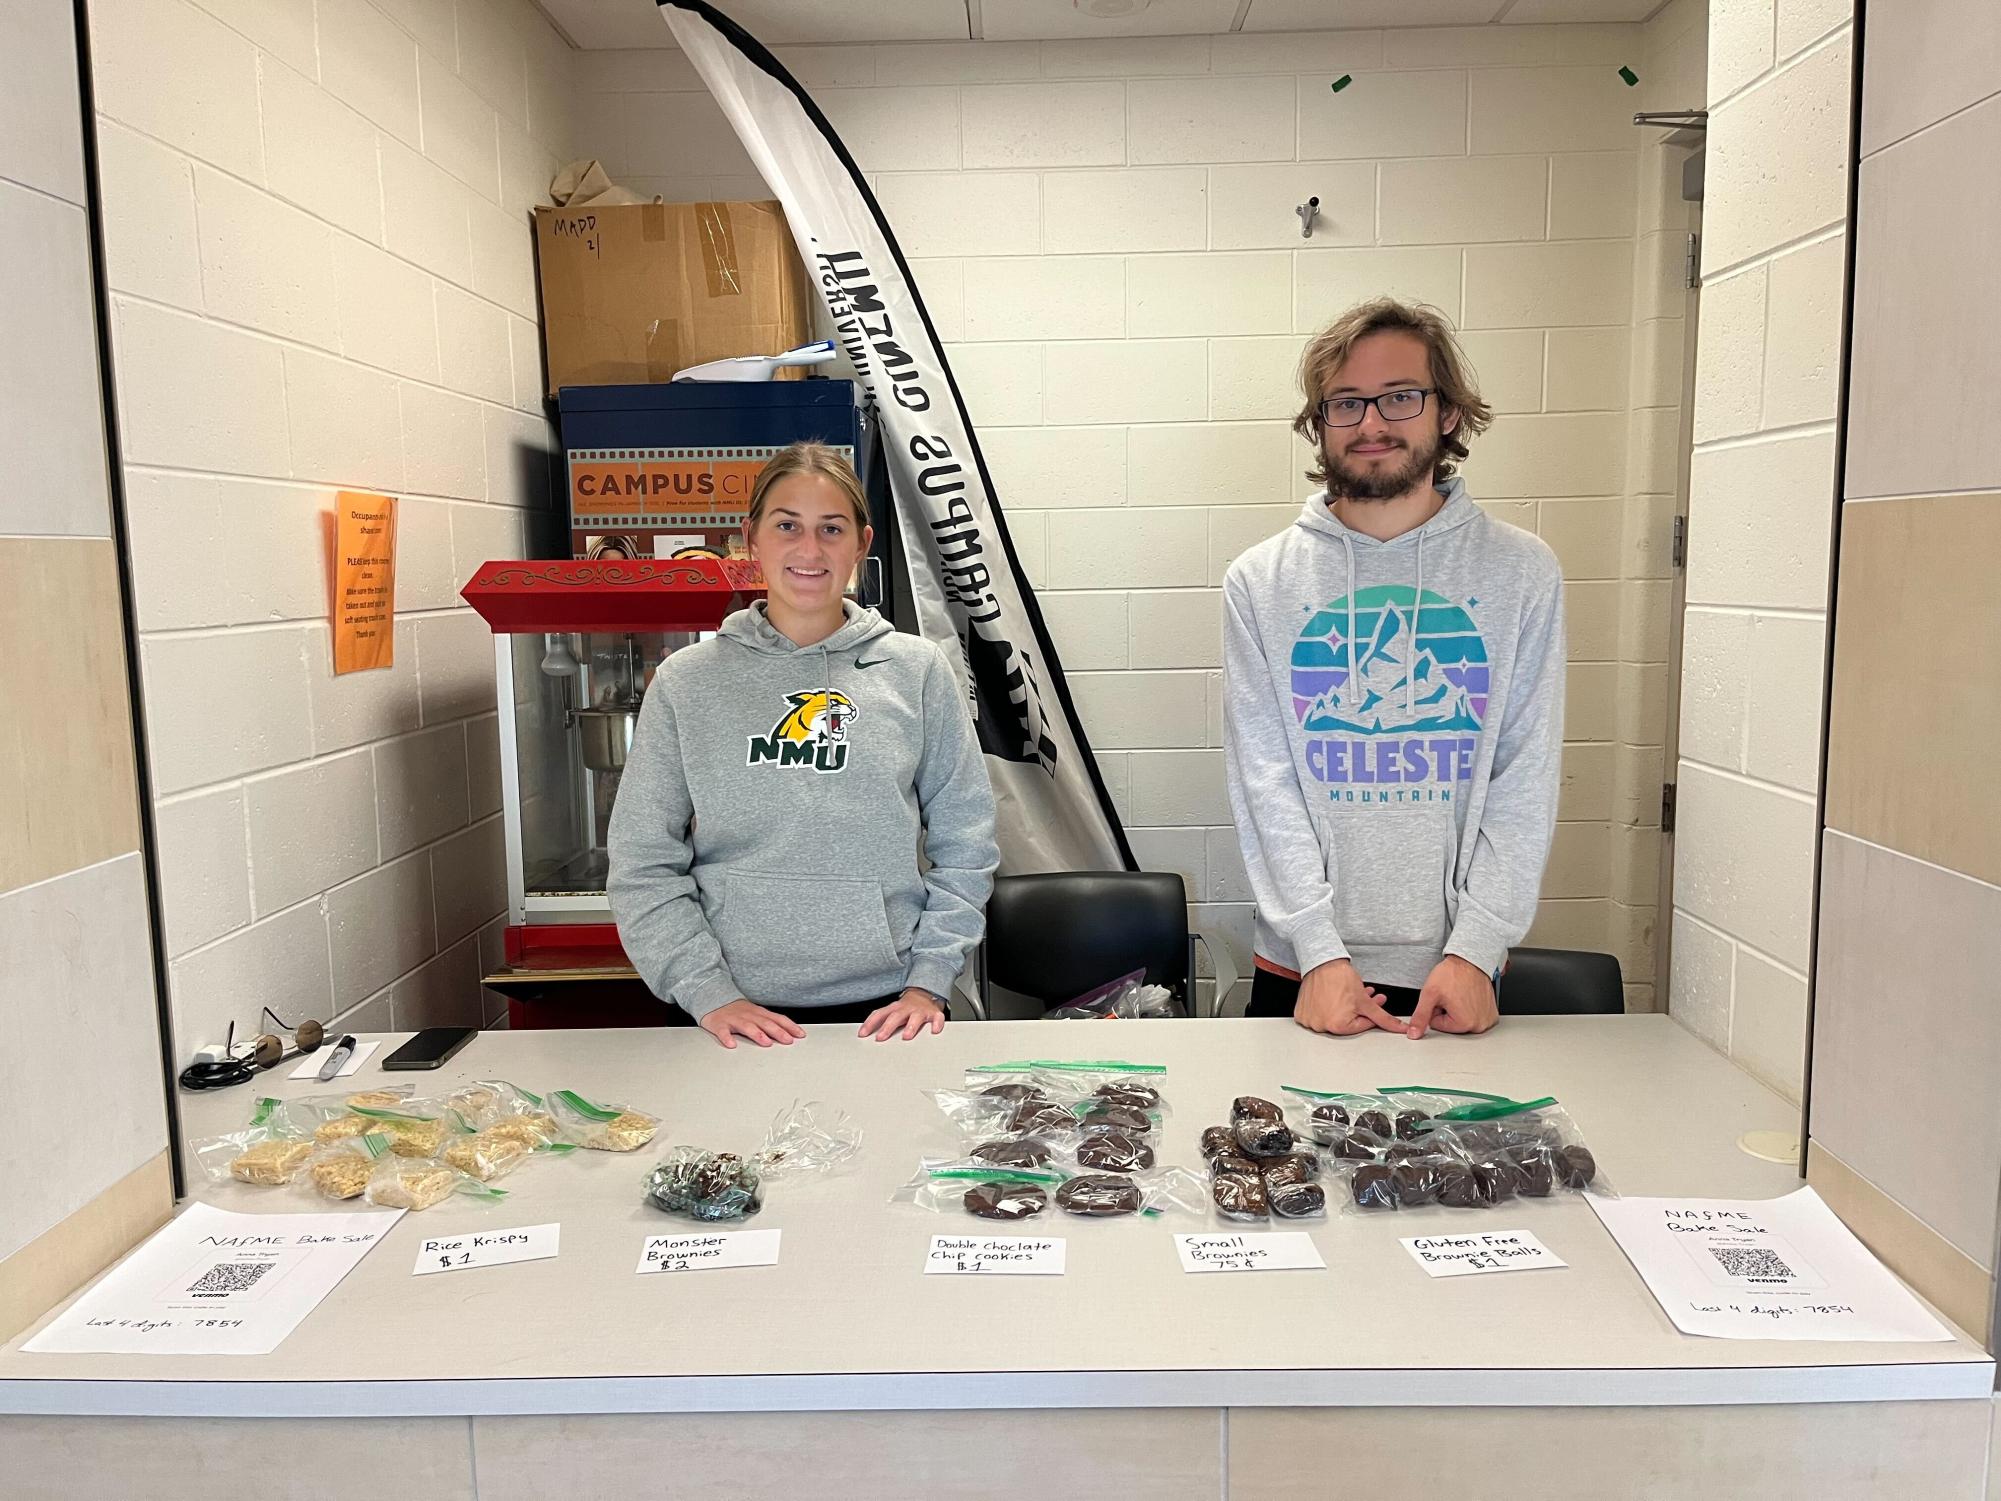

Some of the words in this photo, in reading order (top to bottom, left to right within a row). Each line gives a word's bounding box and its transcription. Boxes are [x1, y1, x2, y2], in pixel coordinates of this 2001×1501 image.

[554, 215, 596, 239] MADD
[577, 473, 715, 496] CAMPUS
[748, 736, 849, 772] NMU
[1305, 738, 1476, 784] CELESTE
[1330, 789, 1451, 803] MOUNTAIN
[1666, 1222, 1719, 1233] Bake
[1726, 1224, 1769, 1233] Sale
[295, 1235, 337, 1245] Bake
[341, 1234, 375, 1244] Sale
[425, 1241, 463, 1252] Rice
[473, 1234, 529, 1247] Krispy
[650, 1237, 728, 1248] Monster
[937, 1239, 977, 1249] Double
[1185, 1237, 1244, 1250] Small
[1414, 1238, 1477, 1250] Gluten
[1481, 1235, 1521, 1247] Free
[647, 1248, 722, 1261] Brownies
[1191, 1249, 1268, 1260] Brownies
[1420, 1250, 1492, 1262] Brownie
[1493, 1246, 1542, 1258] Balls
[1690, 1301, 1722, 1312] Last
[1729, 1304, 1741, 1312] 4
[1803, 1305, 1855, 1314] 7854
[86, 1317, 116, 1327] Last
[119, 1319, 131, 1327] 4
[194, 1319, 244, 1328] 7854
